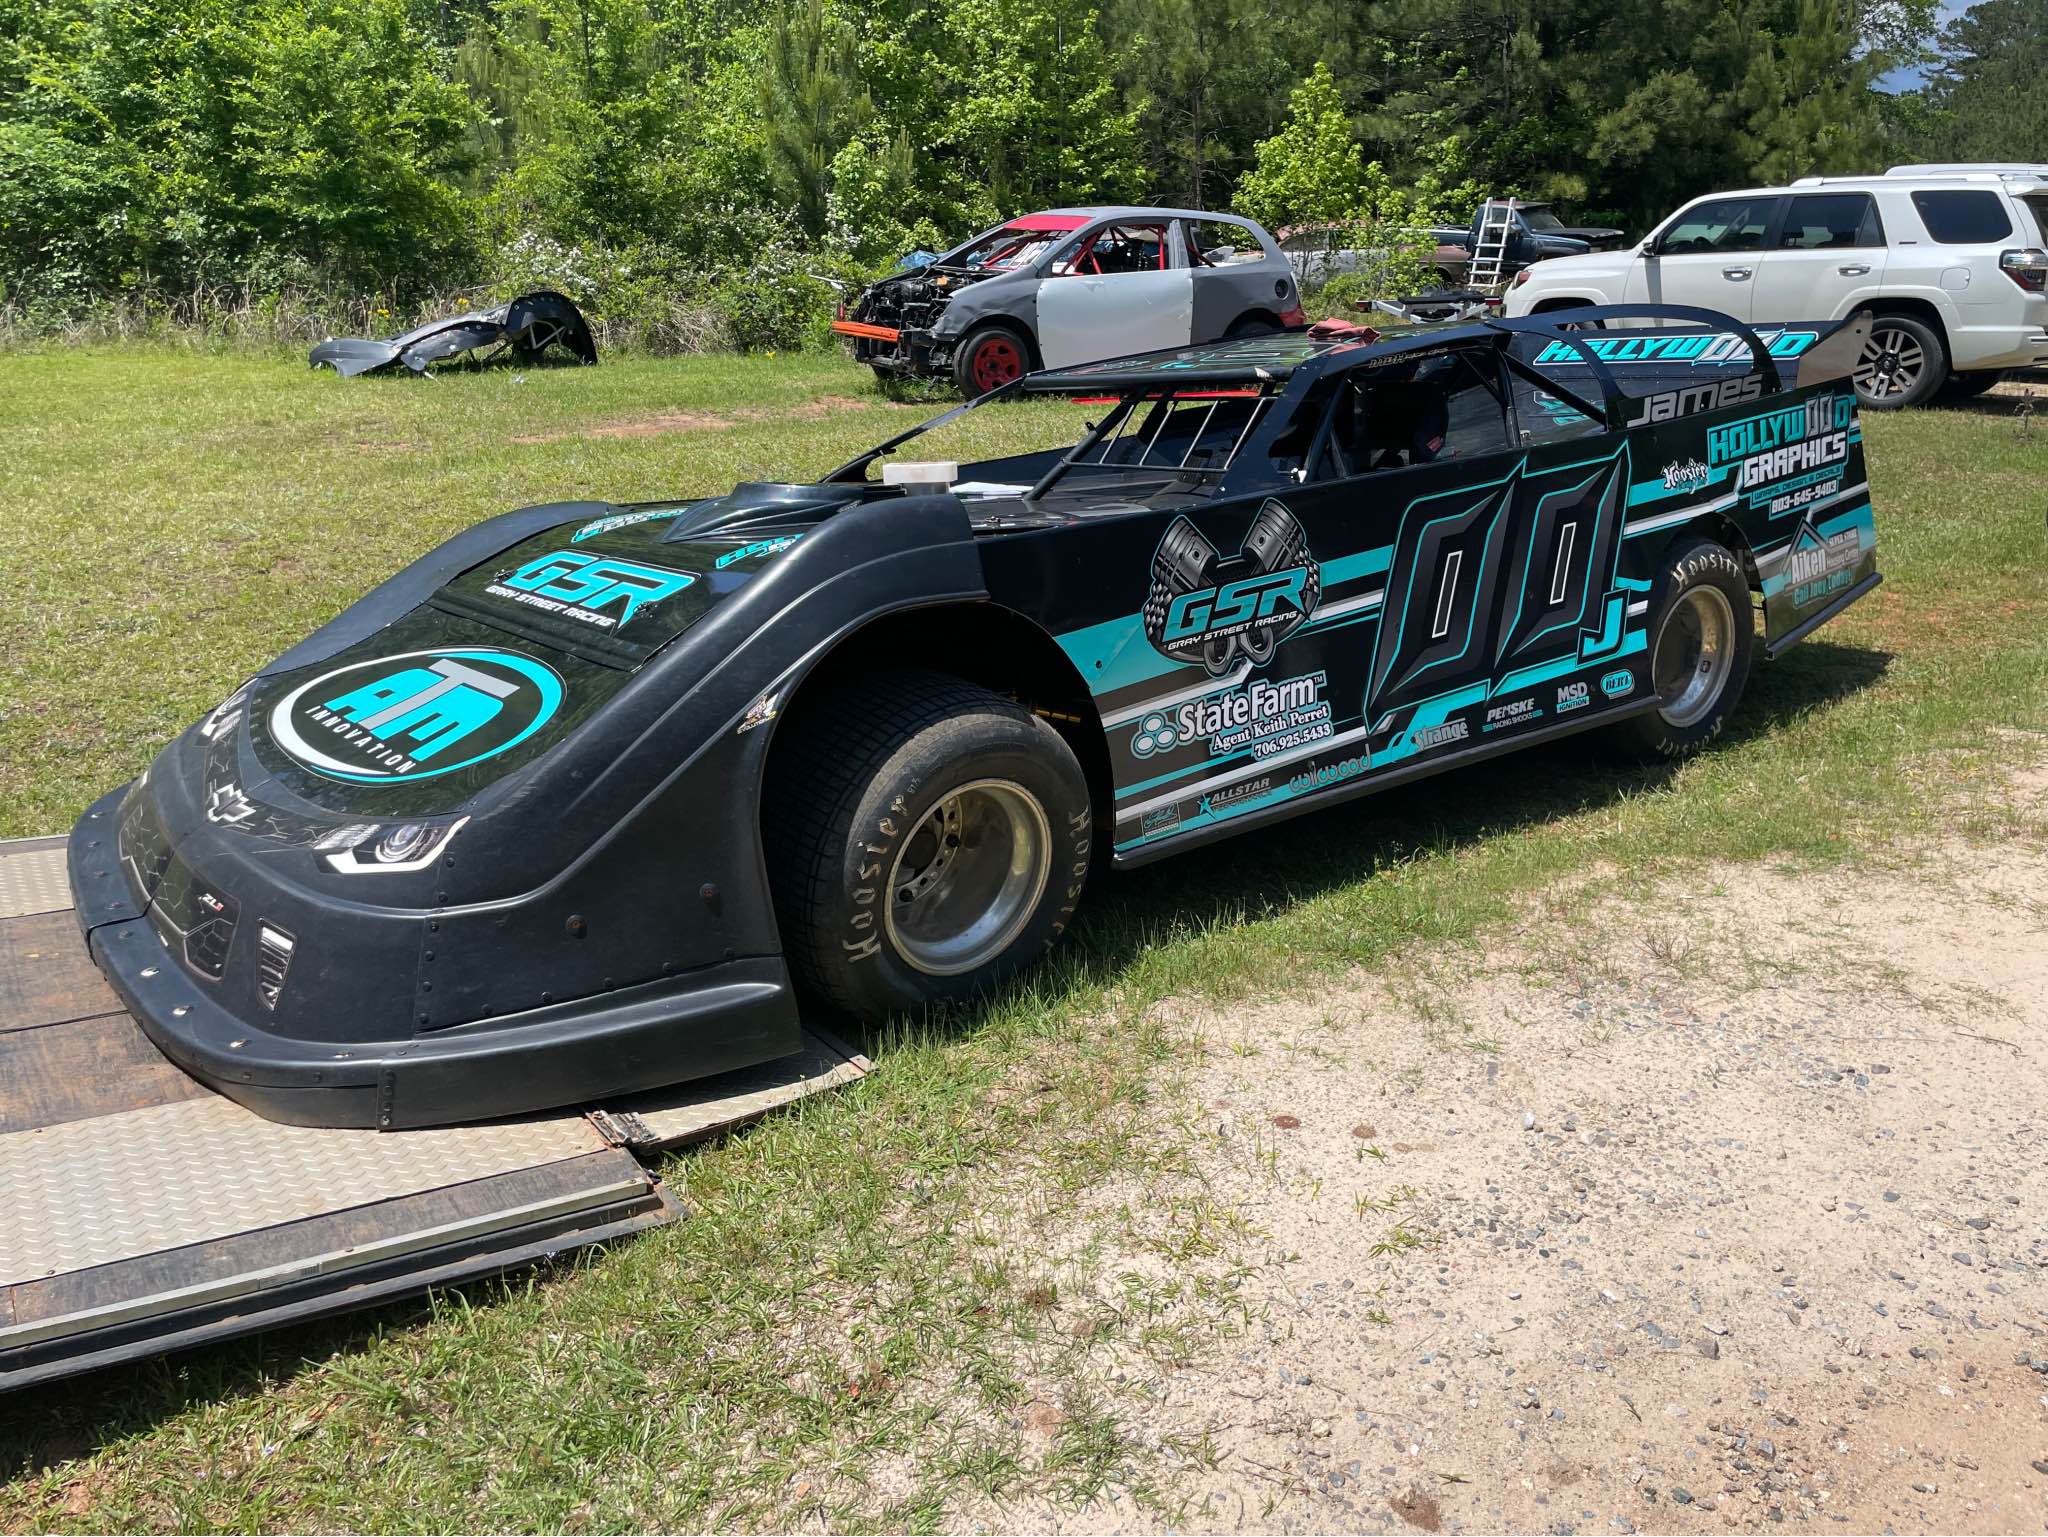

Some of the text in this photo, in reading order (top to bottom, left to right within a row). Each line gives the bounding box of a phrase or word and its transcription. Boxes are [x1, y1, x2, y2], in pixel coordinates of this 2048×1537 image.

[1710, 392, 1849, 464] HOLLYWOOD
[1743, 431, 1847, 488] GRAPHICS
[1771, 479, 1837, 514] 803-645-9403
[1791, 548, 1827, 585] Aiken
[485, 584, 617, 627] GRAY STREET RACING
[501, 550, 696, 629] GSR
[1162, 566, 1312, 643] GSR
[1167, 610, 1298, 651] GRAY STREET RACING
[1486, 697, 1535, 723] PENSKE
[1557, 681, 1588, 704] MSD
[1558, 697, 1588, 712] IGNITION
[305, 705, 417, 773] INNOVATION
[1213, 705, 1329, 751] Agent Keith Perret
[1254, 723, 1332, 758] 706.925.5433
[1211, 777, 1270, 804] ALLSTAR
